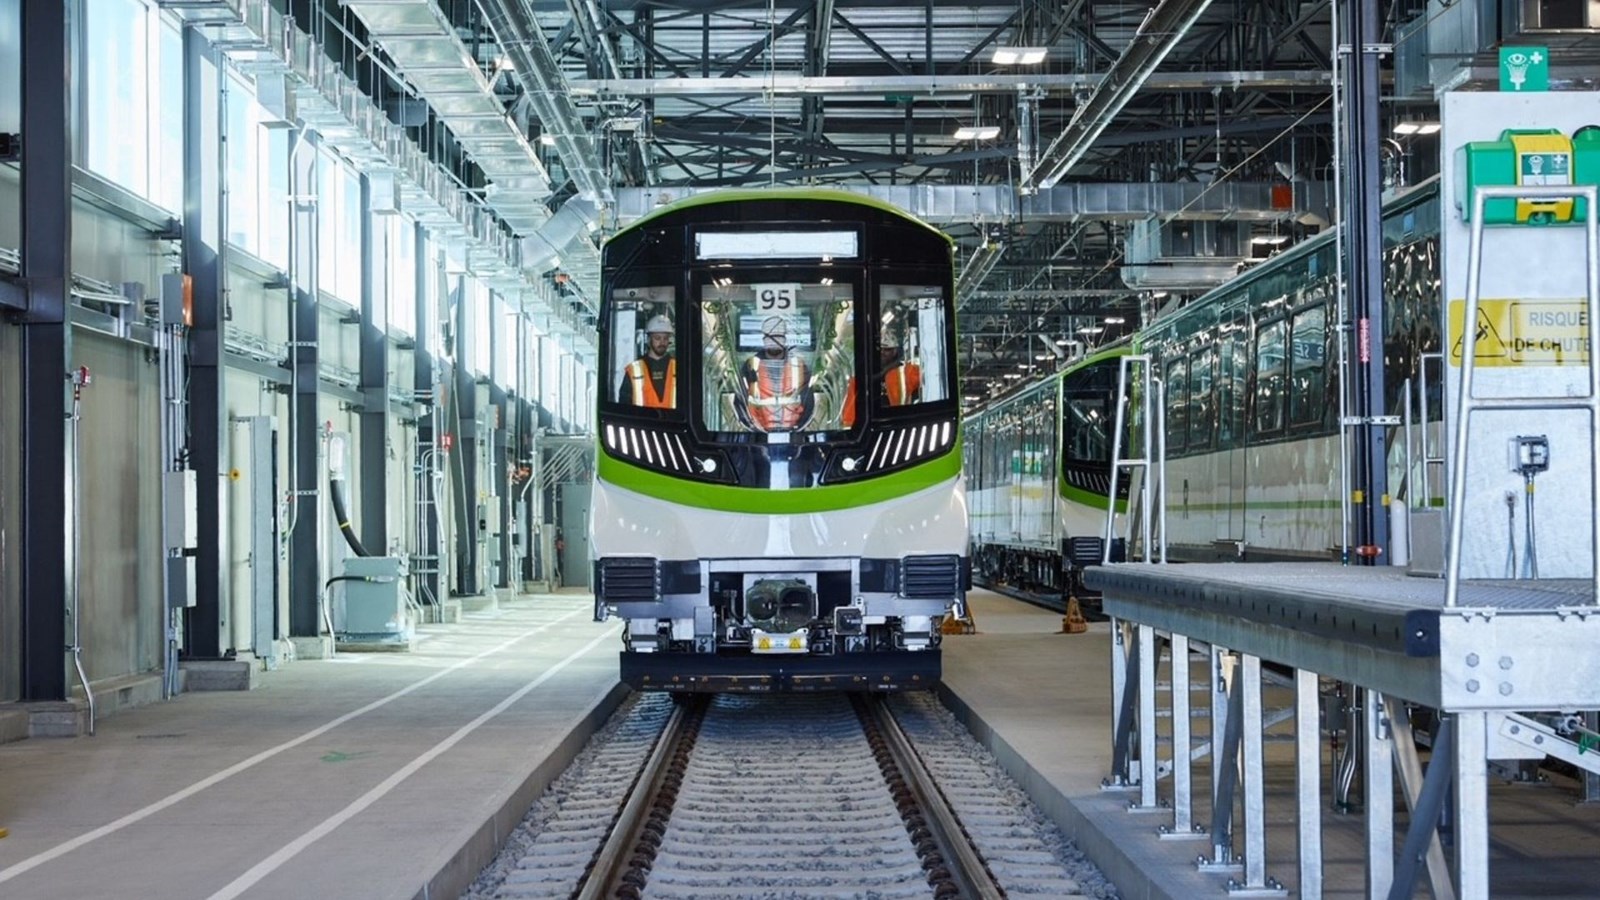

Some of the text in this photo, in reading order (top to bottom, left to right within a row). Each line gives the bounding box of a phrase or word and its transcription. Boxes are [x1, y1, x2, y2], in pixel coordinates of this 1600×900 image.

[761, 290, 791, 310] 95
[1529, 311, 1588, 327] RISQUE
[1515, 337, 1535, 352] DE
